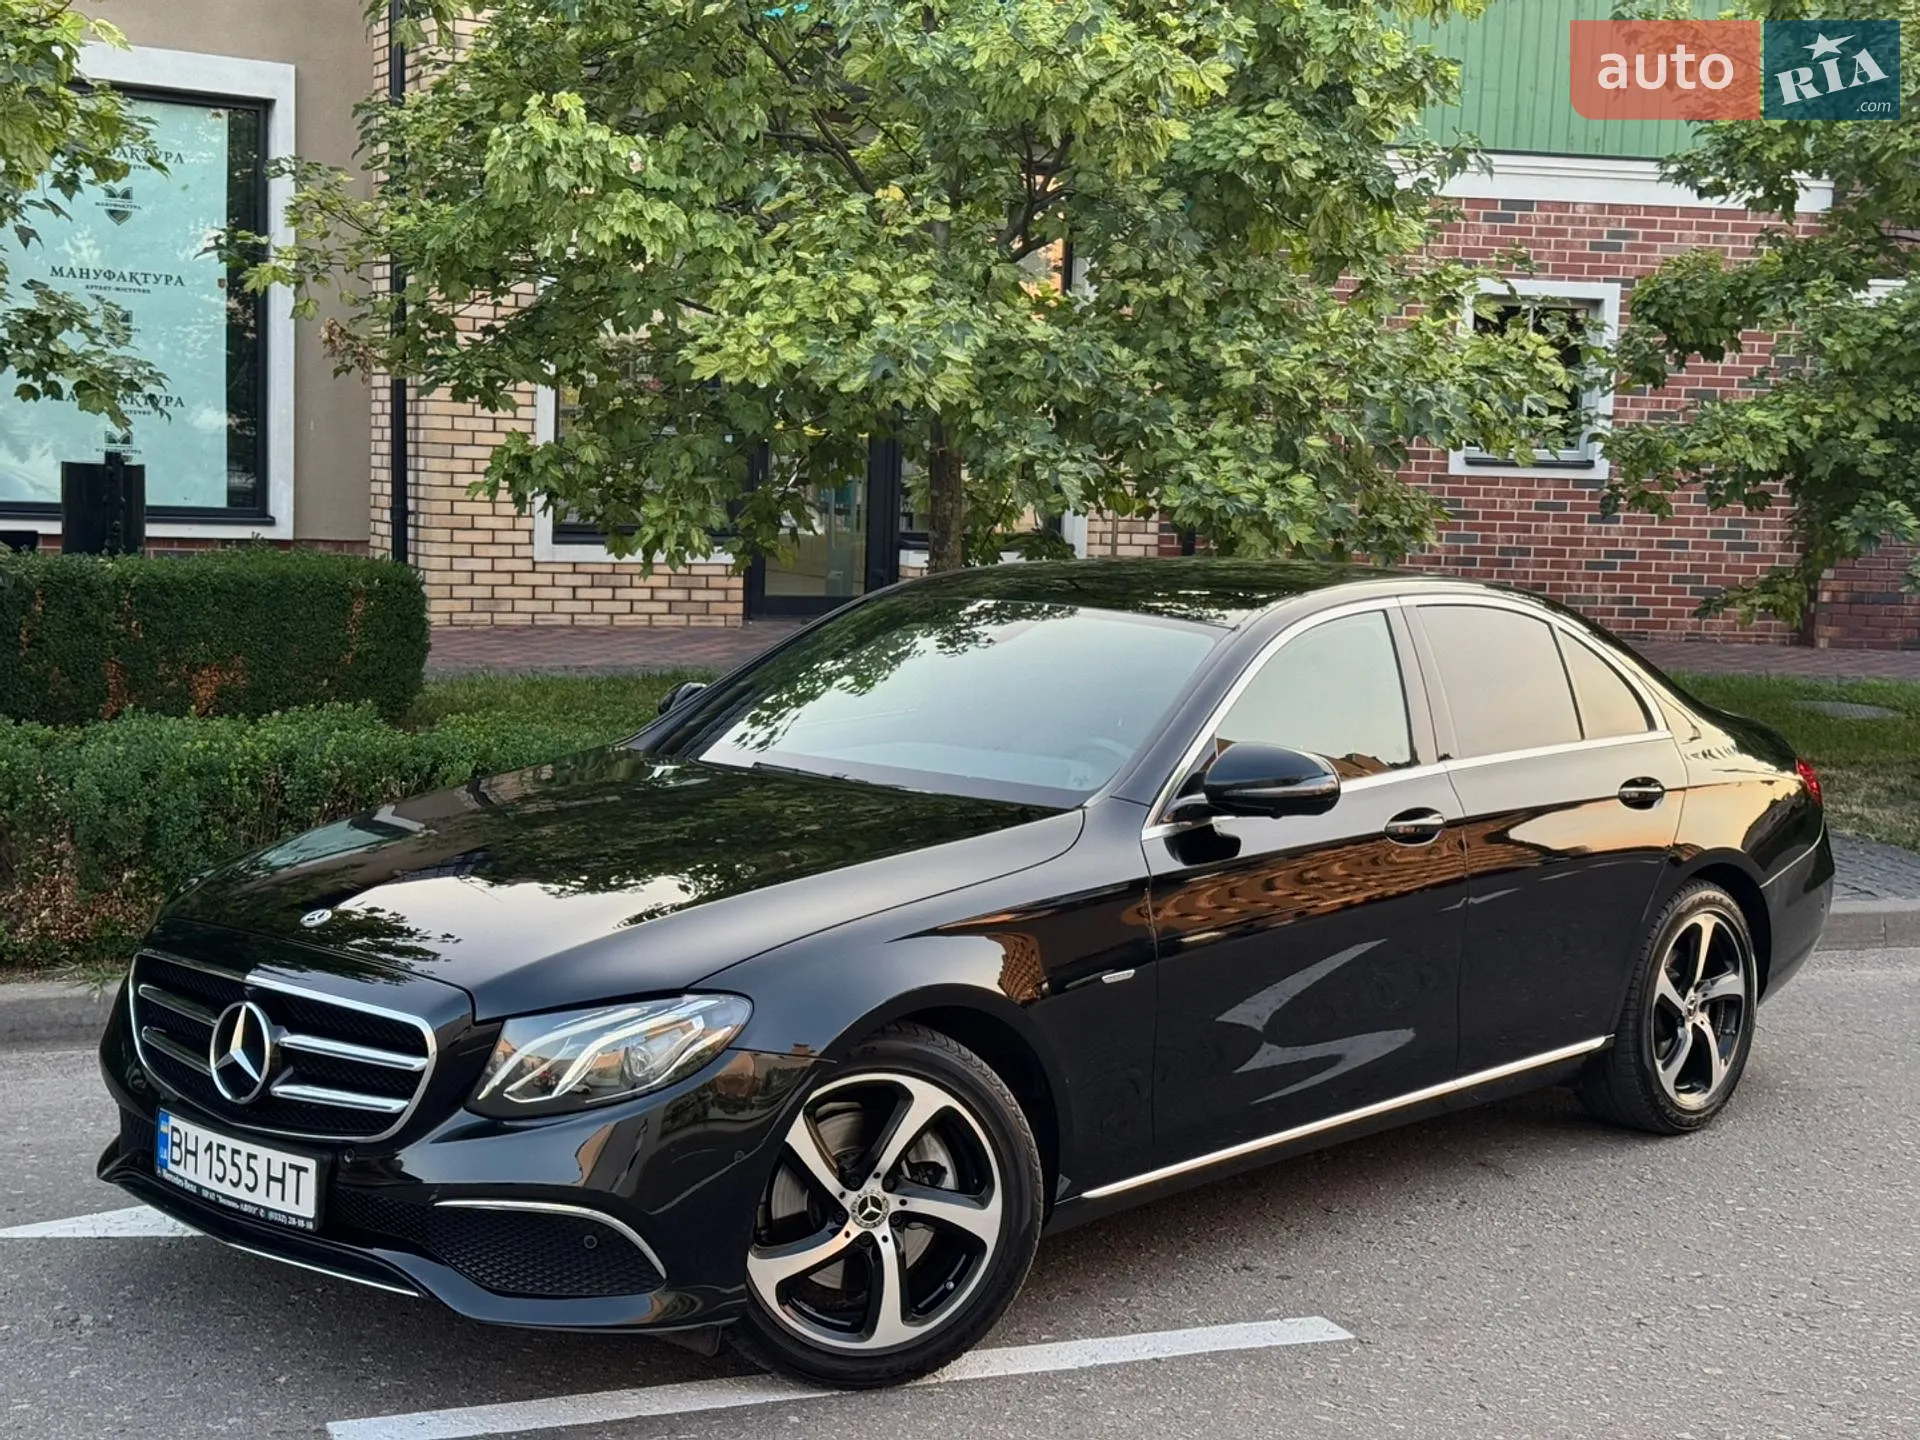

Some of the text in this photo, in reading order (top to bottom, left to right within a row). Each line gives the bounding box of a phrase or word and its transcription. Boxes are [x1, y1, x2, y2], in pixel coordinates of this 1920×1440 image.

[49, 265, 186, 287] МАНУФАКТУРА
[170, 1125, 199, 1175] BH
[203, 1140, 258, 1193] 1555
[265, 1157, 309, 1206] HT
